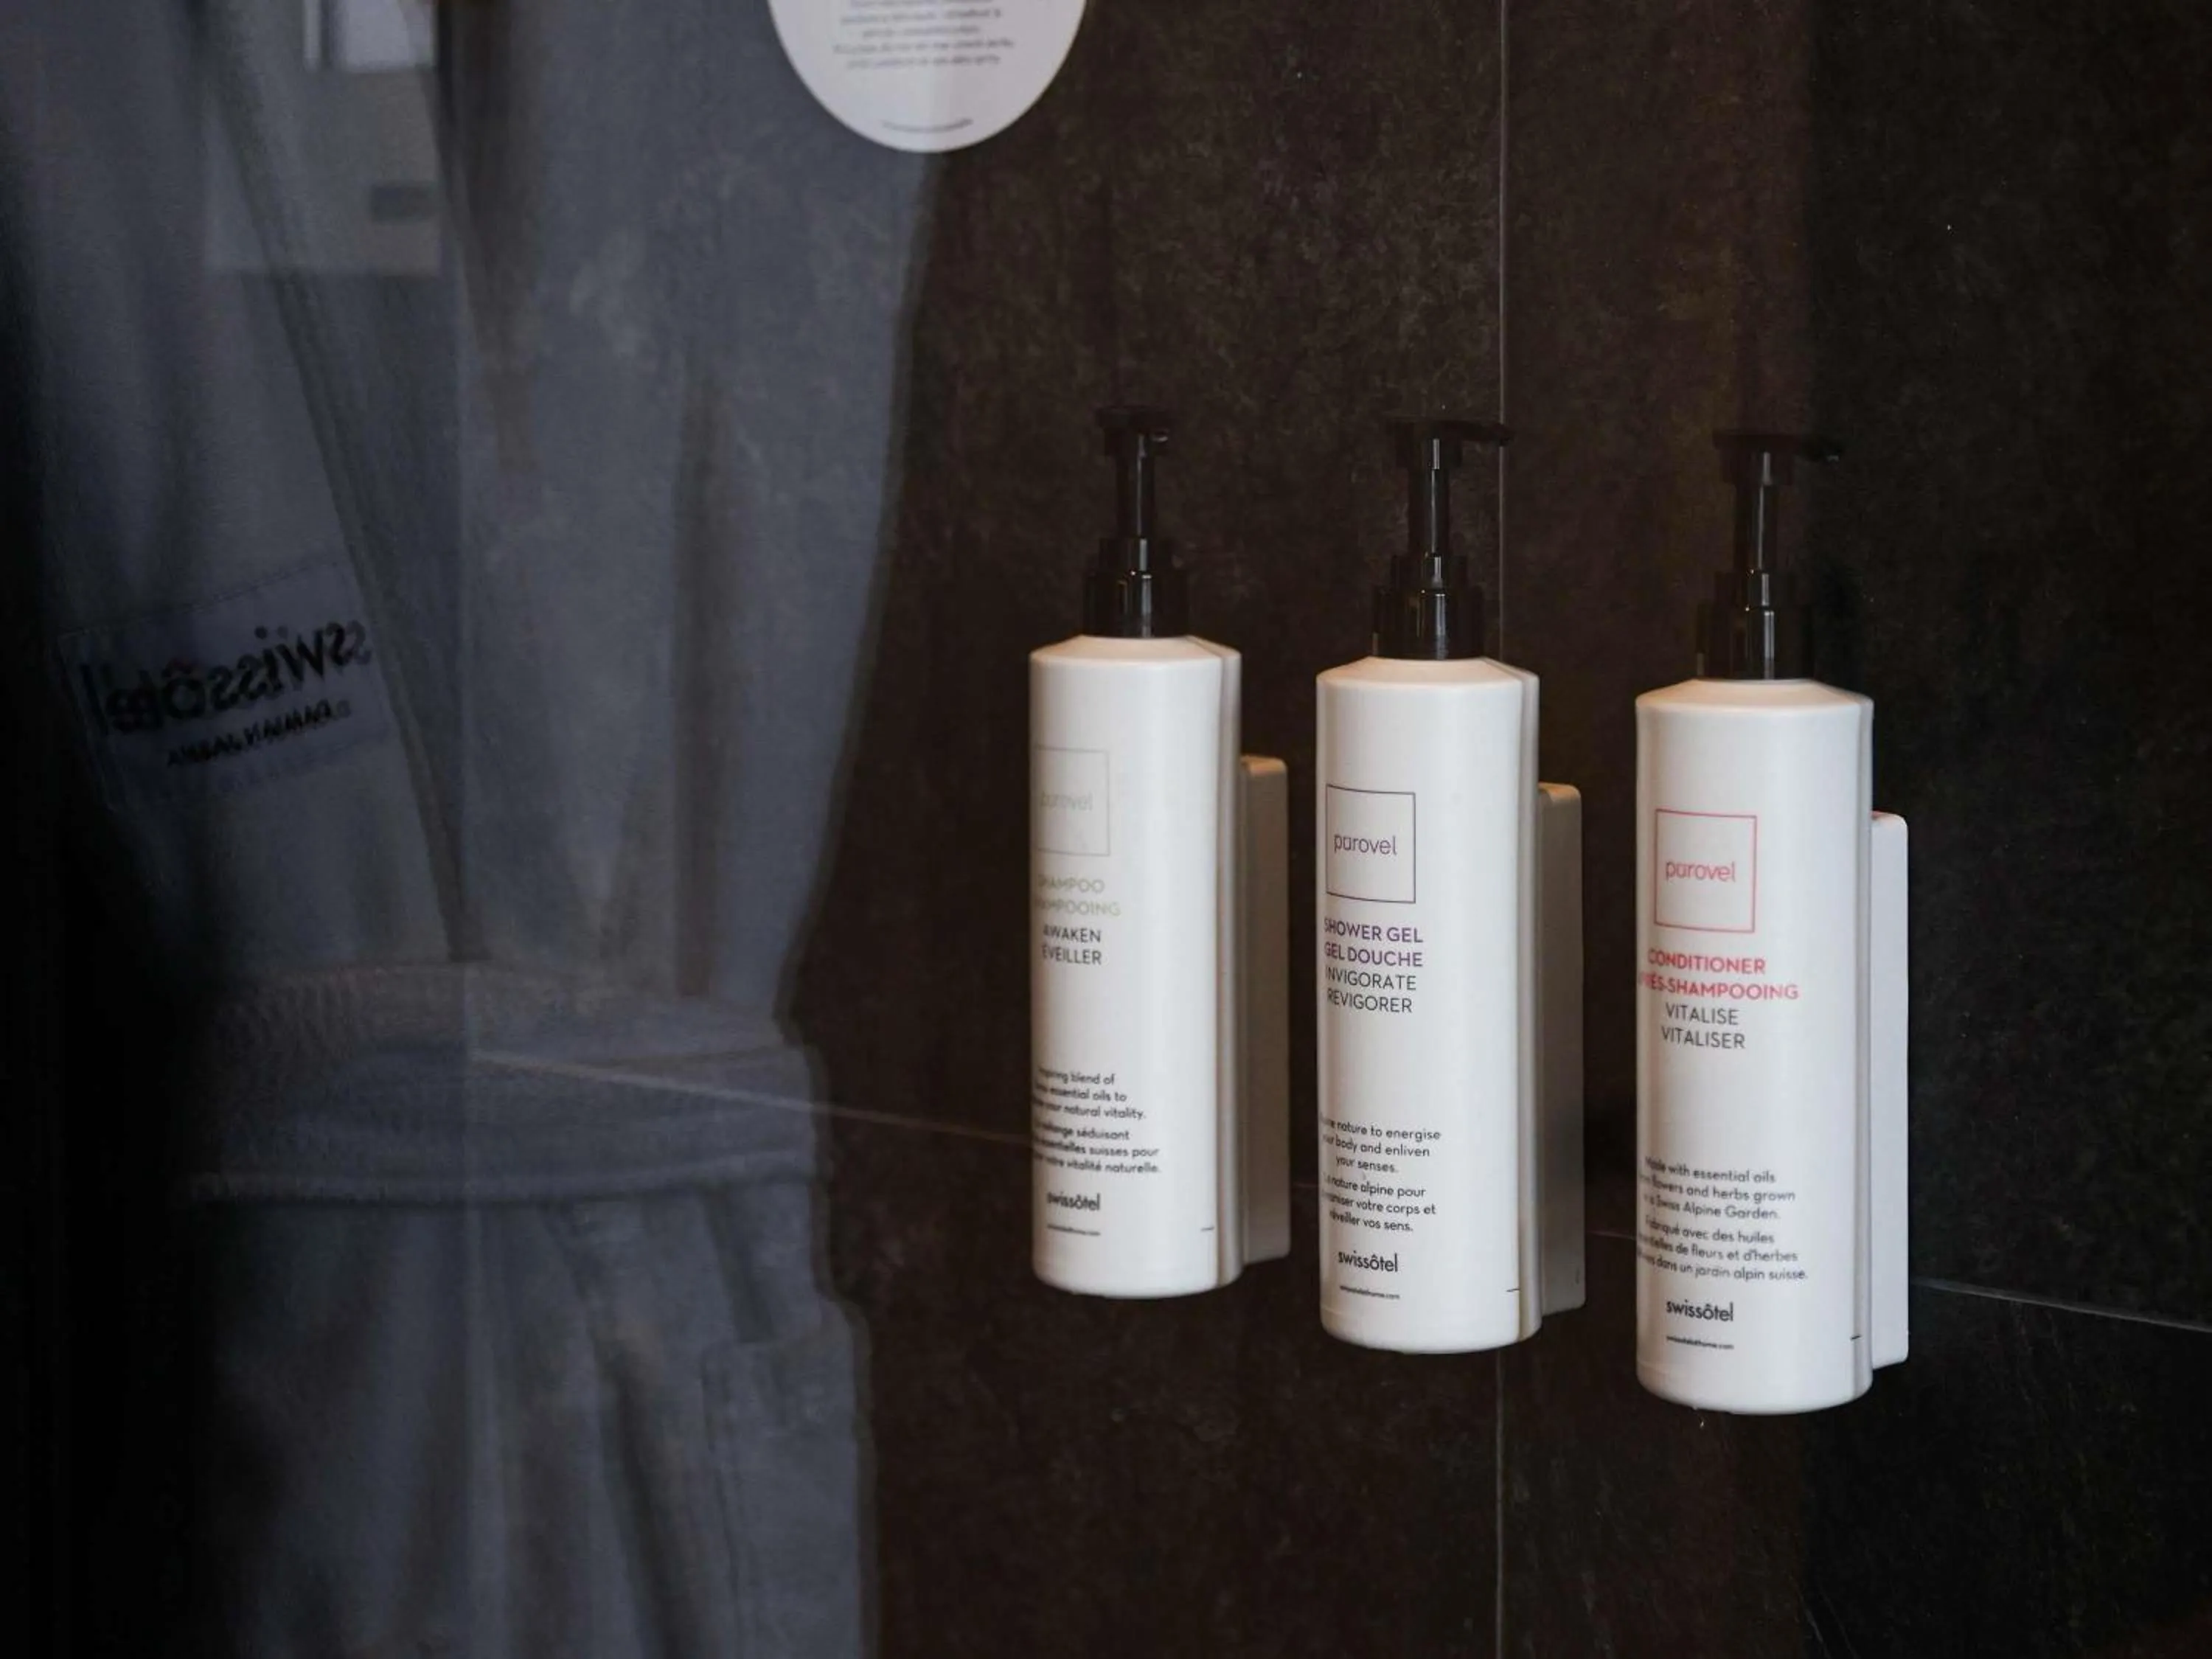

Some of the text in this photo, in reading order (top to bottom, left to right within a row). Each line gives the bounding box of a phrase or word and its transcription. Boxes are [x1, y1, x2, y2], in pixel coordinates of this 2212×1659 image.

[1043, 924, 1102, 943] AWAKEN
[1324, 917, 1424, 943] SHOWER GEL
[1324, 941, 1423, 967] GEL DOUCHE
[1647, 948, 1766, 975] CONDITIONER
[1325, 965, 1416, 991] INVIGORATE
[1327, 987, 1413, 1013] REVIGORER
[1665, 1002, 1739, 1026] VITALISE
[1660, 1026, 1746, 1049] VITALISER
[1103, 1073, 1116, 1085] of
[1093, 1089, 1111, 1102] oils
[1115, 1091, 1127, 1102] to
[1104, 1107, 1147, 1120] vitality.
[1370, 1123, 1382, 1137] to
[1385, 1128, 1441, 1143] energise
[1089, 1144, 1129, 1157] suisses
[1132, 1147, 1160, 1158] pour
[1335, 1135, 1357, 1154] body
[1360, 1141, 1382, 1155] and
[1385, 1144, 1430, 1157] enliven
[1105, 1162, 1161, 1174] naturelle.
[1357, 1160, 1399, 1174] senses.
[1668, 1162, 1691, 1178] with
[1693, 1167, 1750, 1183] essential
[1753, 1171, 1776, 1184] oils
[1360, 1180, 1394, 1197] alpine
[1397, 1188, 1426, 1199] pour
[1686, 1183, 1709, 1199] and
[1713, 1186, 1750, 1201] herbs
[1753, 1189, 1796, 1205] grown
[1356, 1199, 1384, 1213] votre
[1386, 1204, 1421, 1217] corps
[1423, 1203, 1437, 1215] et
[1682, 1200, 1722, 1218] Alpine
[1725, 1205, 1781, 1220] Garden.
[1363, 1218, 1381, 1230] vos
[1384, 1220, 1413, 1232] sens.
[1682, 1228, 1709, 1241] avec
[1711, 1228, 1735, 1242] des
[1737, 1230, 1775, 1245] huiles
[1338, 1251, 1398, 1273] swissôtel
[1674, 1242, 1690, 1256] de
[1691, 1244, 1724, 1260] fleurs
[1725, 1247, 1740, 1260] et
[1743, 1248, 1798, 1263] d'herbes
[1680, 1262, 1694, 1274] un
[1694, 1262, 1731, 1279] jardin
[1733, 1265, 1766, 1281] alpin
[1768, 1267, 1808, 1281] suisse.
[1666, 1298, 1734, 1322] swissôtel
